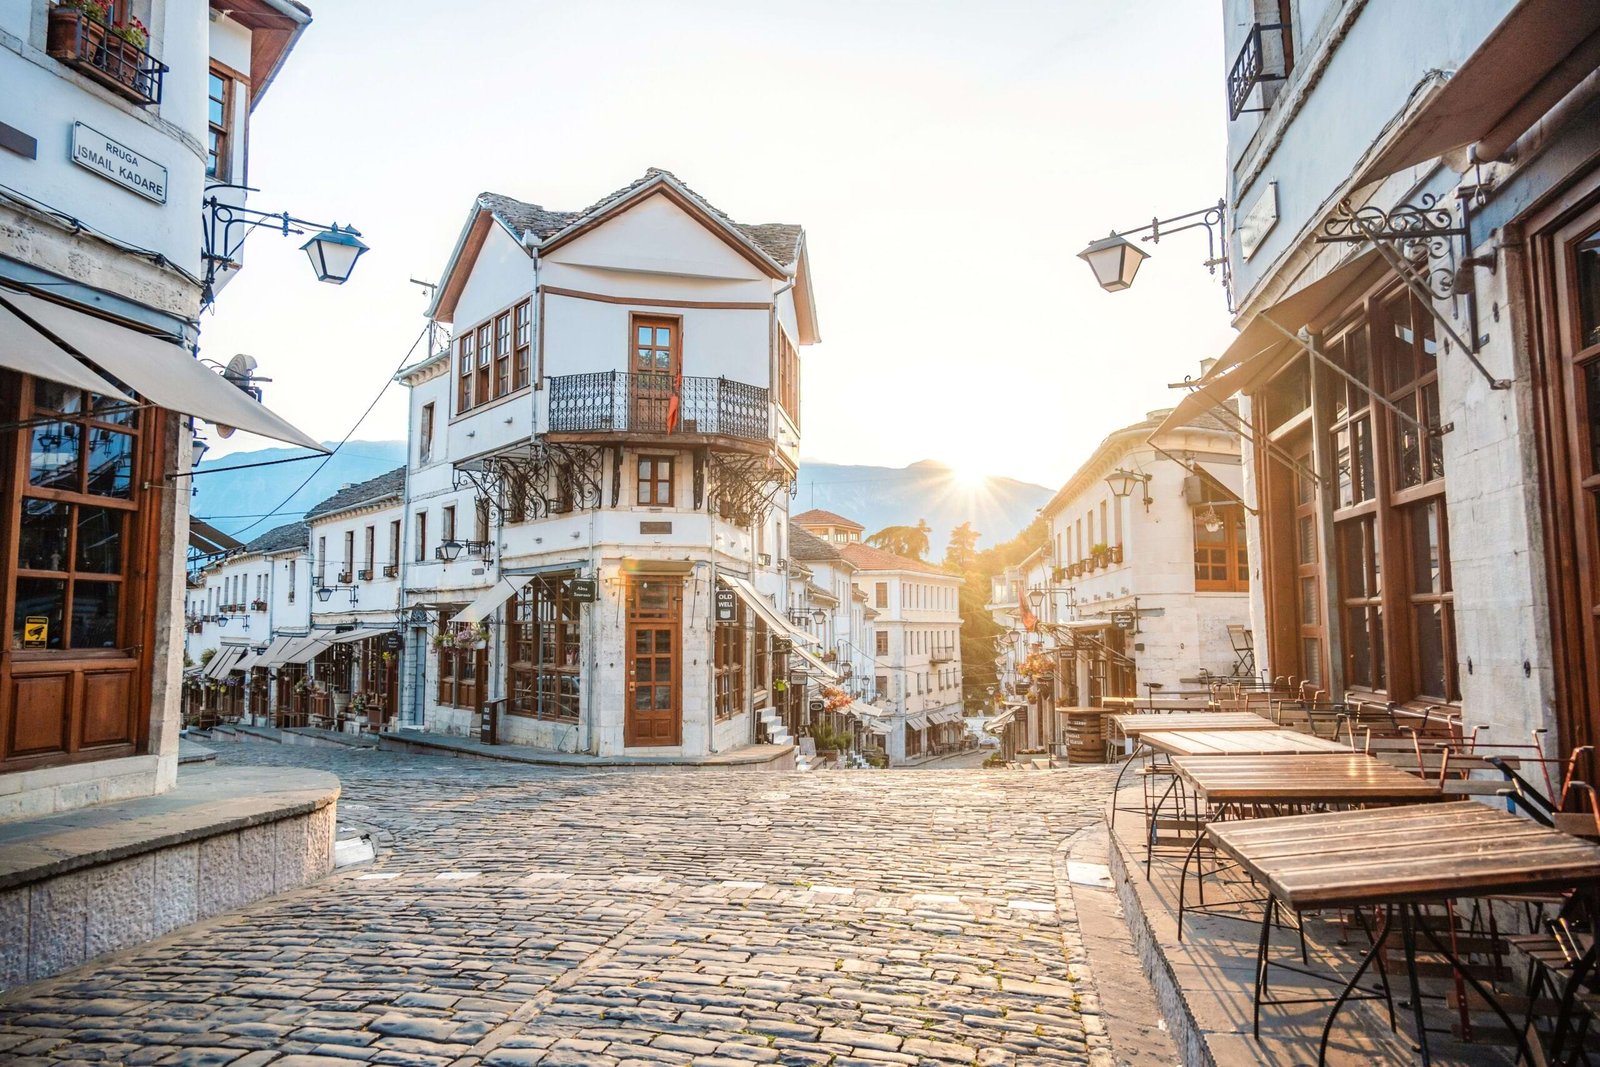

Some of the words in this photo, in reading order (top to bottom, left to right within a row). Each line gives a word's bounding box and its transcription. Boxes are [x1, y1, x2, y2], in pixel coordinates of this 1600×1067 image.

[77, 144, 115, 173] ISMAIL
[119, 166, 163, 197] KADARE
[105, 142, 139, 167] RRUGA
